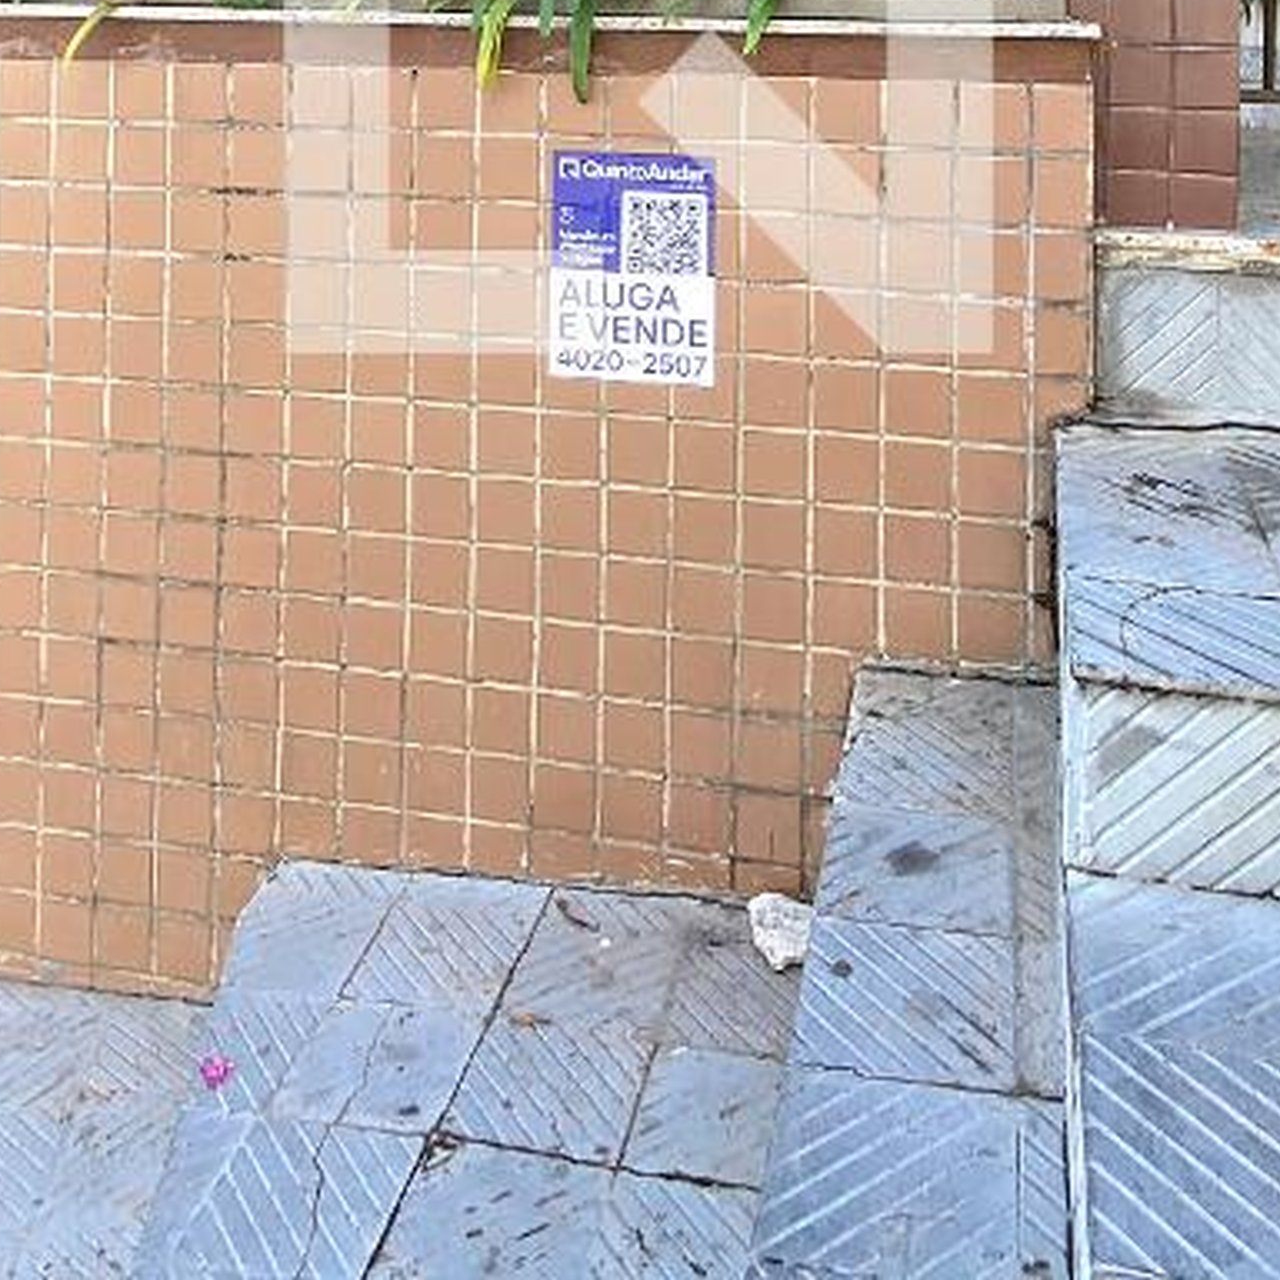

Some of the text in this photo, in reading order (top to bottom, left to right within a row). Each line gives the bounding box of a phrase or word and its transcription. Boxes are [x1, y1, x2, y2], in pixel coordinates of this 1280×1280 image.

[559, 279, 681, 313] ALUGA
[559, 312, 708, 348] E VENDE
